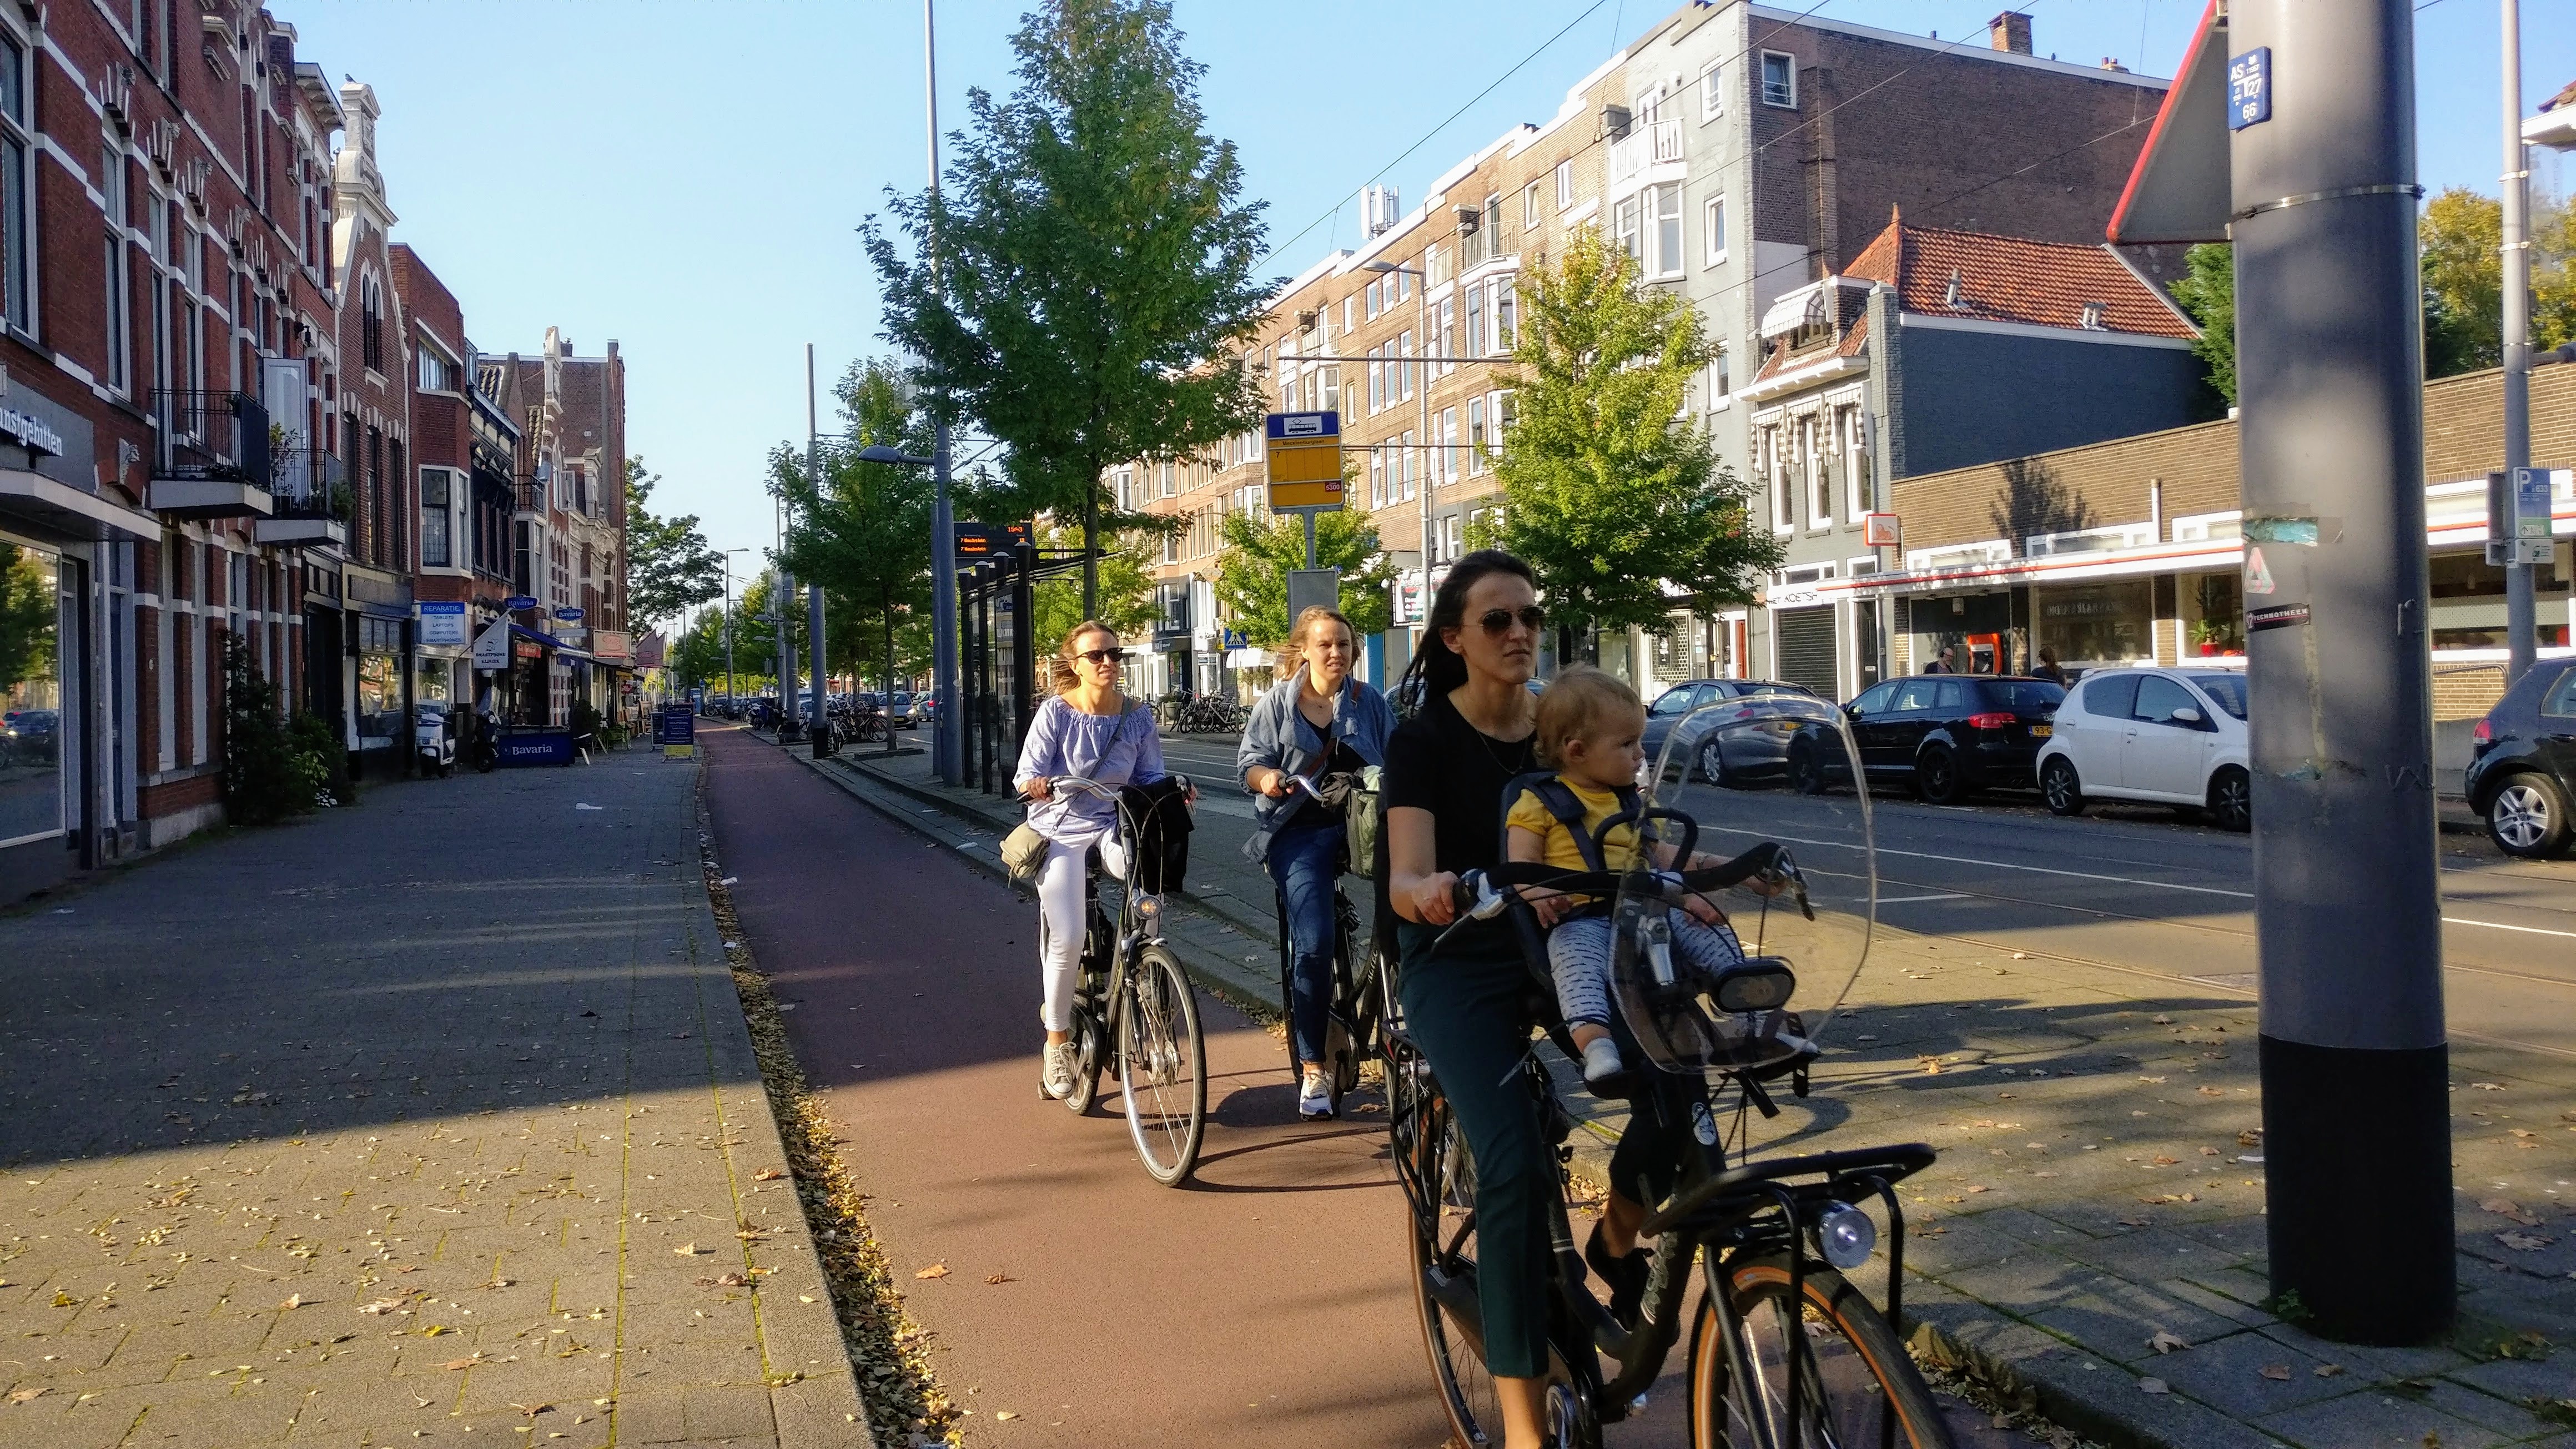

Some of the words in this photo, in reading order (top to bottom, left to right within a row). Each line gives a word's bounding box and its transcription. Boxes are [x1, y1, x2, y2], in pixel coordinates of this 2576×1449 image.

[2230, 63, 2244, 82] AS
[2242, 102, 2257, 119] 66
[2518, 470, 2532, 492] P
[2253, 608, 2307, 621] TECHNOTHEEK
[512, 744, 553, 755] Bavaria
